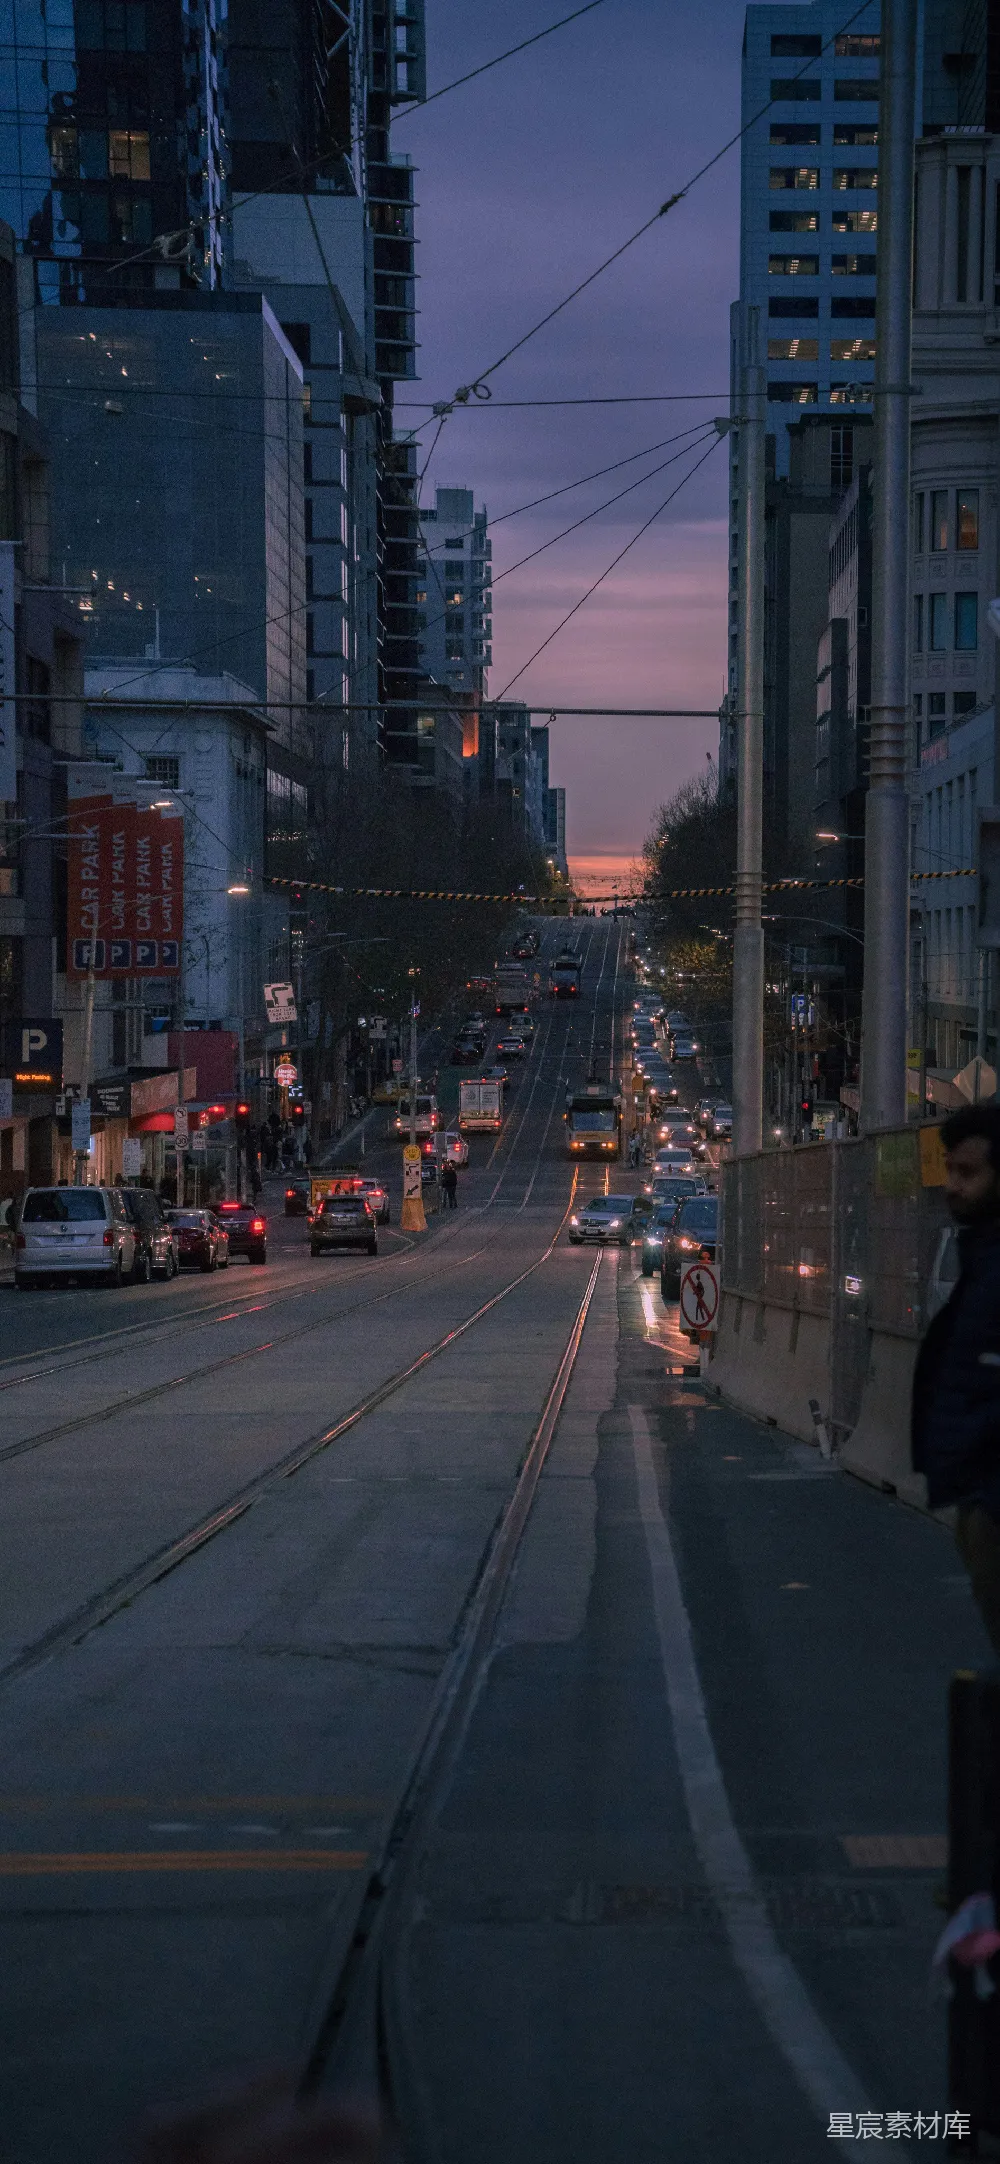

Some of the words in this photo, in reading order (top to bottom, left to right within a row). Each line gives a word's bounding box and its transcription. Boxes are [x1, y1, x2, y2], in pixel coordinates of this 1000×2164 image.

[80, 822, 100, 881] PARK
[136, 835, 151, 887] PARK
[80, 886, 99, 930] CAR
[136, 891, 151, 931] CAR
[112, 946, 123, 962] P
[137, 946, 149, 962] P
[21, 1028, 48, 1062] P
